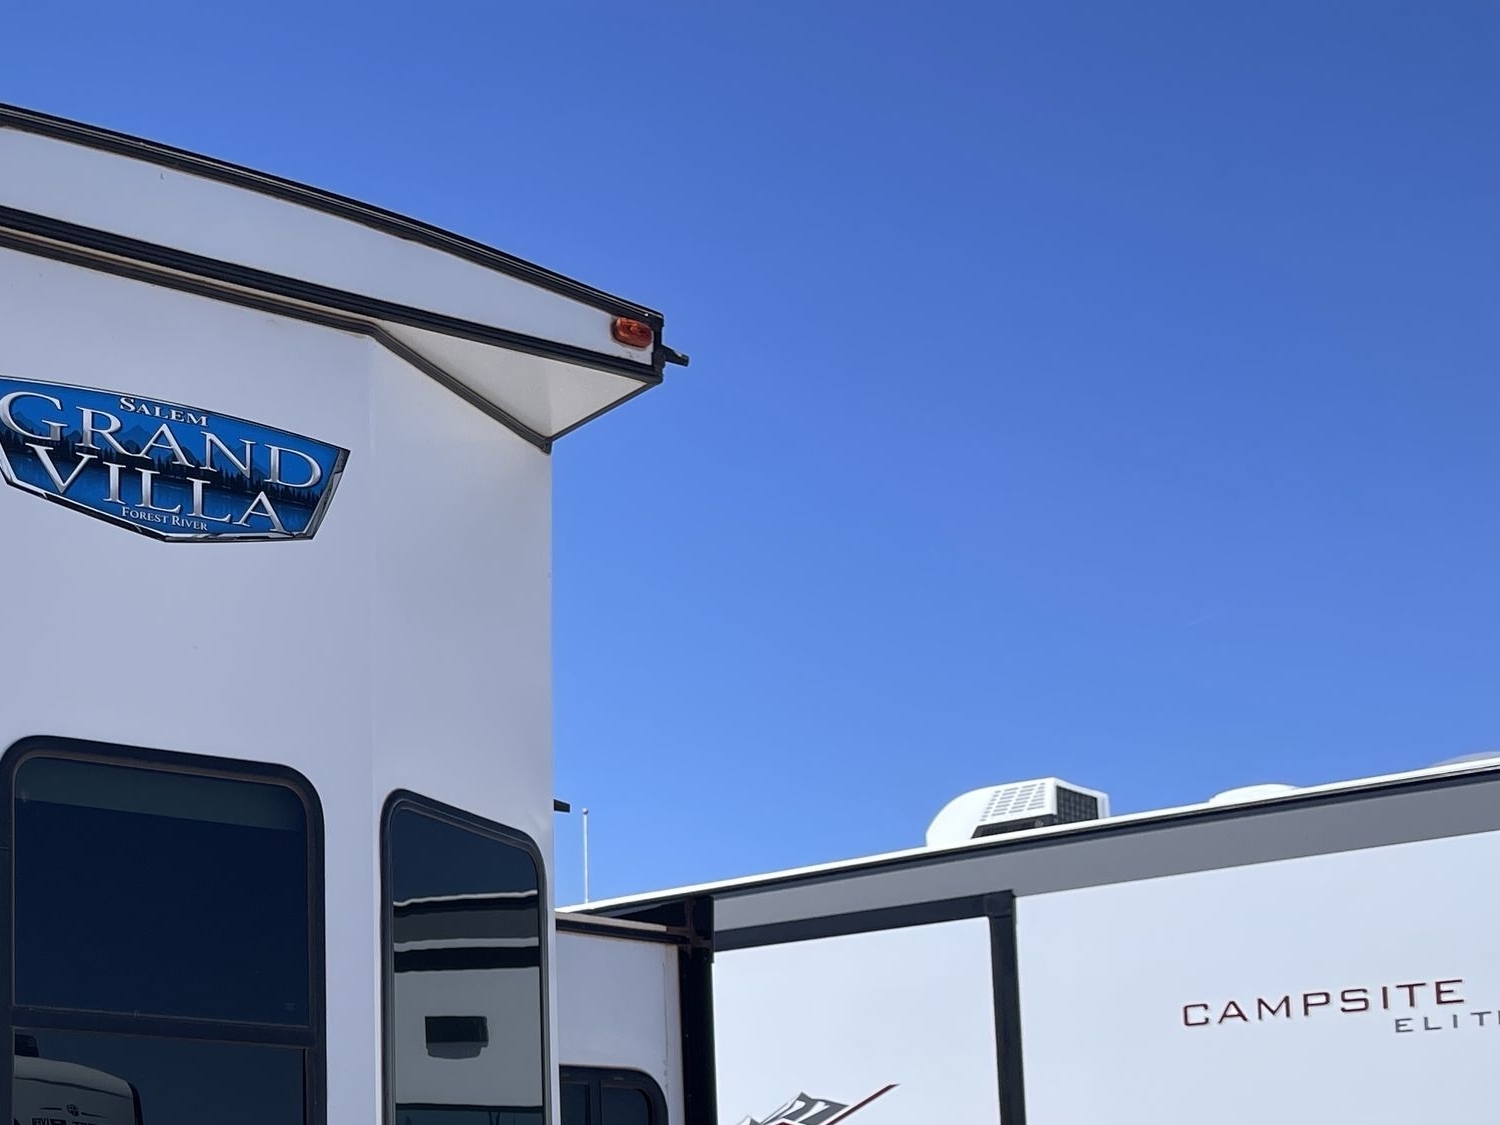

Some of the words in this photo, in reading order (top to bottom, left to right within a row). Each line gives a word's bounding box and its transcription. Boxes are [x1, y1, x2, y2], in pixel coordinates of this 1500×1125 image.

[119, 397, 208, 427] SALEM
[24, 443, 288, 534] VILLA
[121, 506, 169, 525] FOREST
[171, 515, 208, 532] RIVER
[1182, 979, 1466, 1027] CAMPSITE
[1394, 1010, 1500, 1033] ELIT
